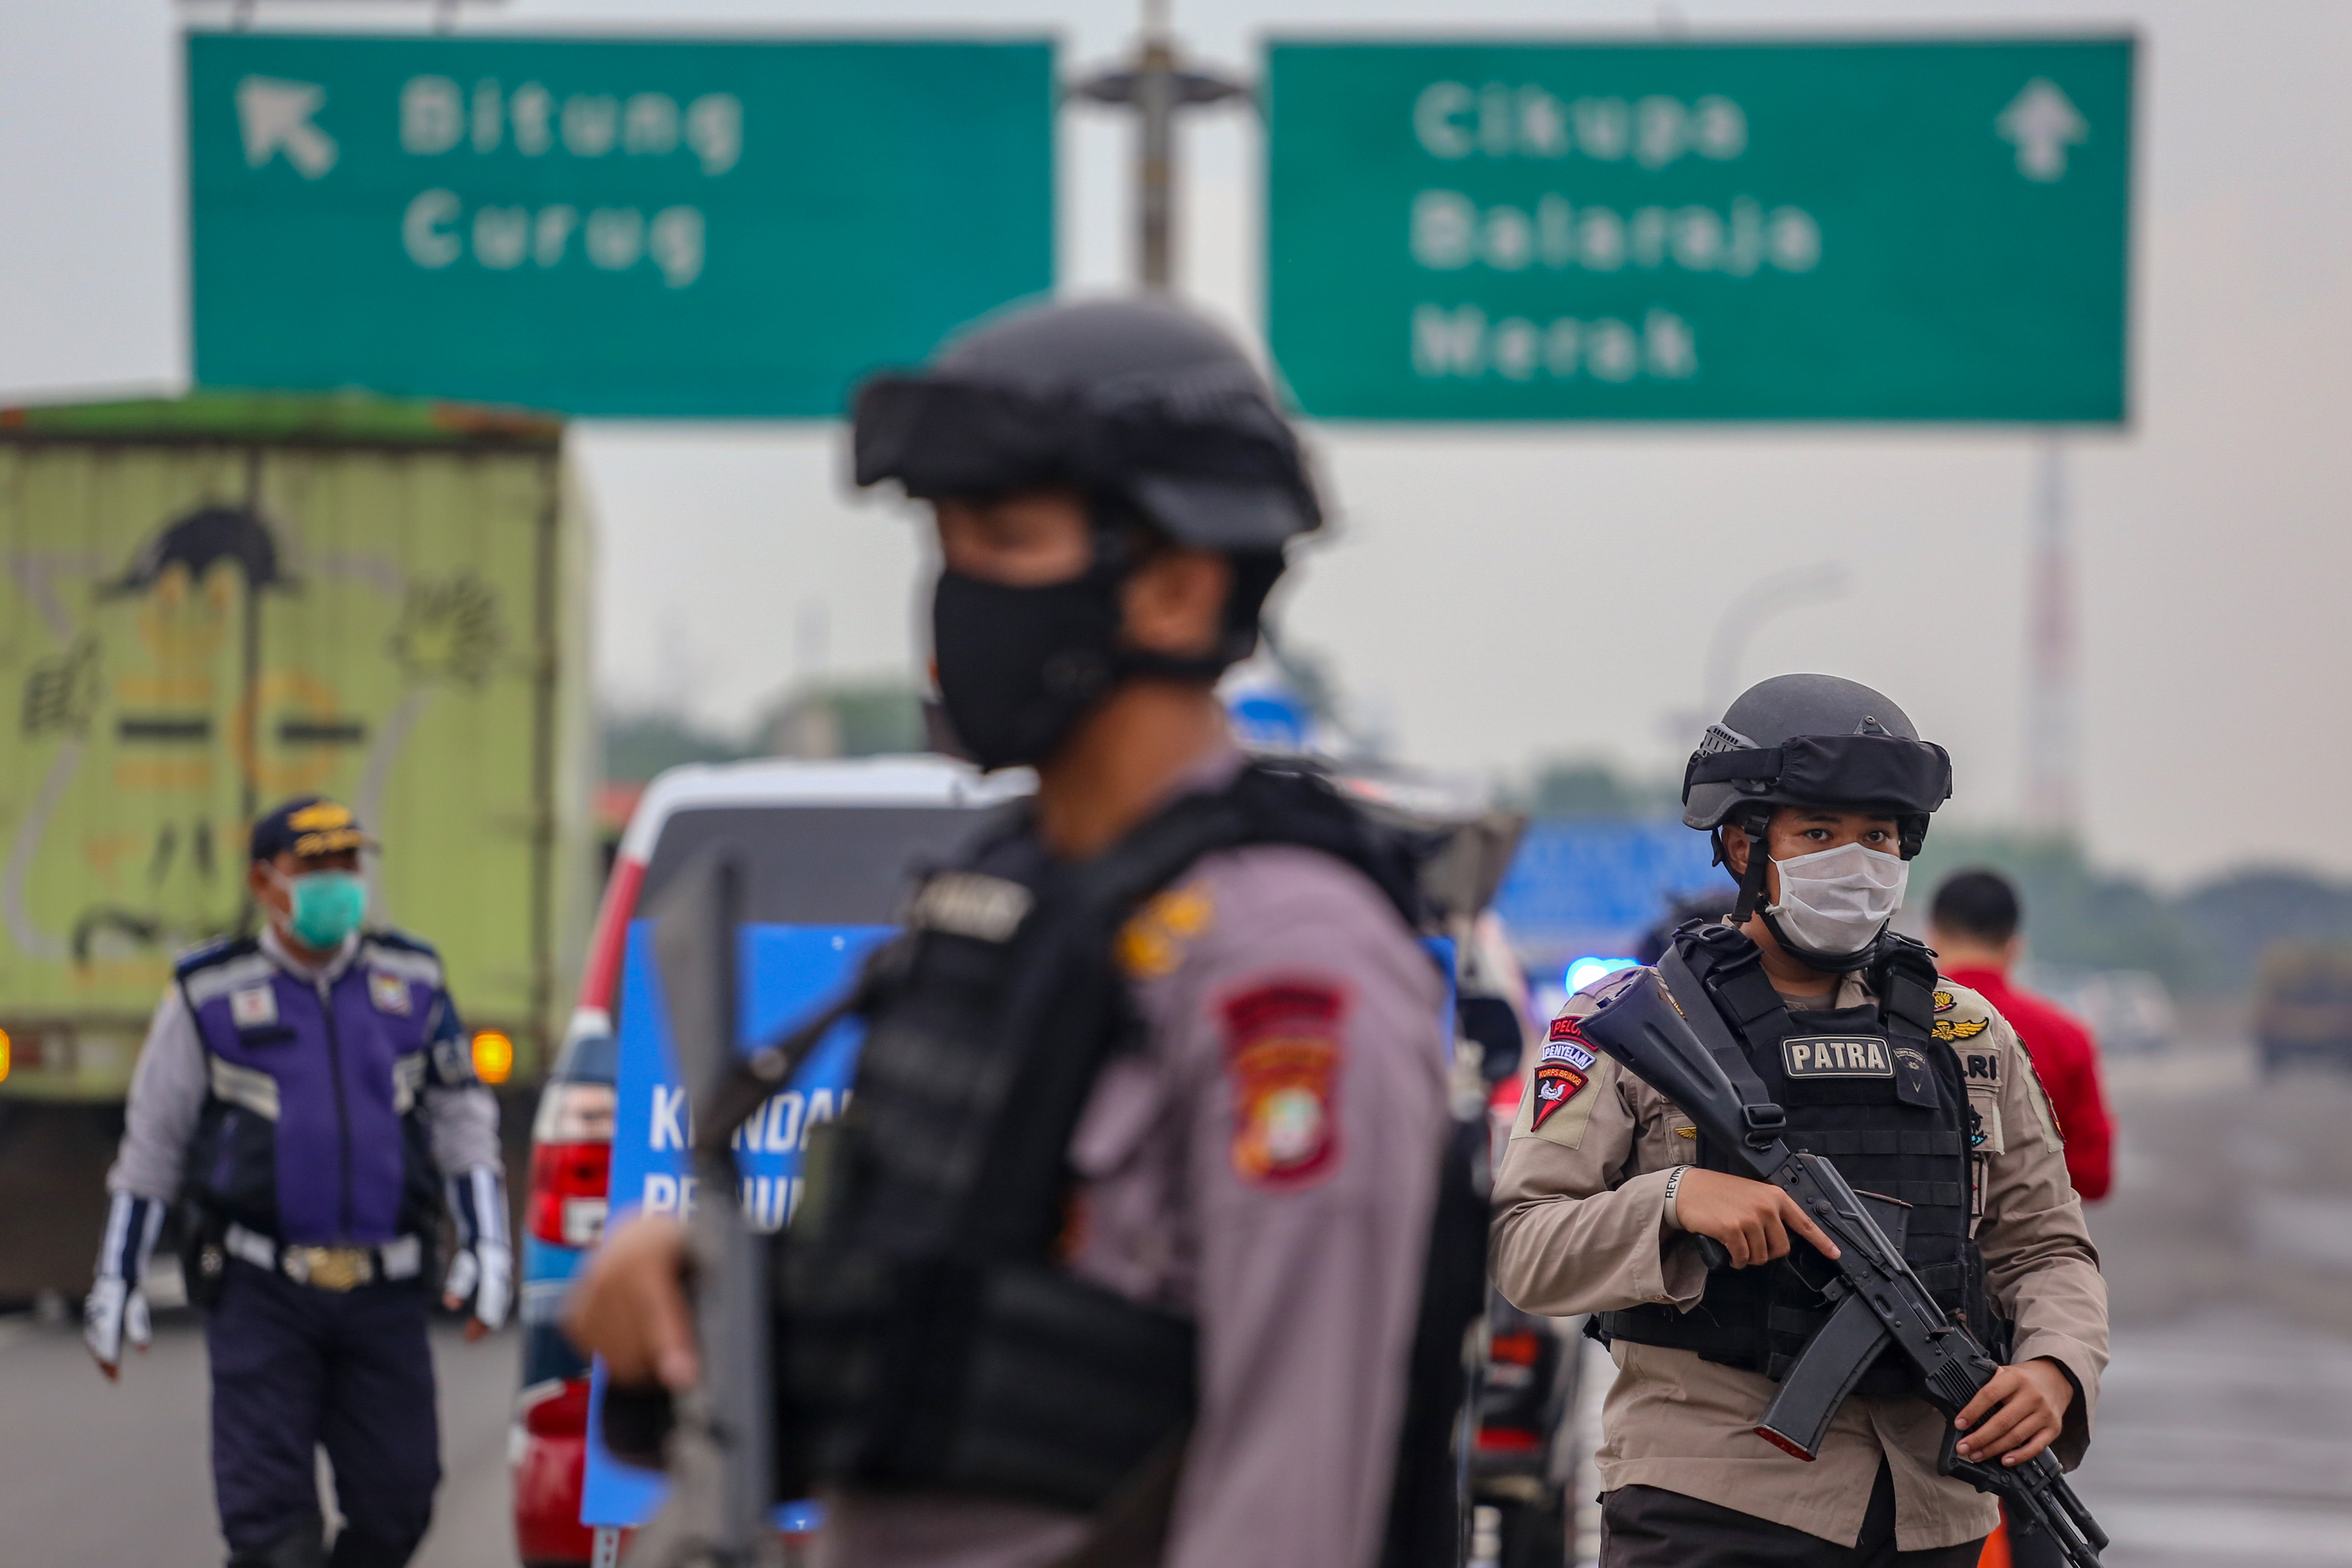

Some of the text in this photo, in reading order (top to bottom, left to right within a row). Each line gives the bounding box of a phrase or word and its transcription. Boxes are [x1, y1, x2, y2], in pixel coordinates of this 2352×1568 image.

[399, 75, 741, 175] Bitung
[1414, 82, 1746, 168] Cikupa
[402, 189, 704, 287] Curug
[1411, 189, 1820, 277] Balaraja
[1412, 305, 1696, 380] Merak
[1538, 1069, 1582, 1085] KORPS BRIMOB
[1545, 1045, 1589, 1066] PENYELAM
[1792, 1043, 1886, 1070] PATRA
